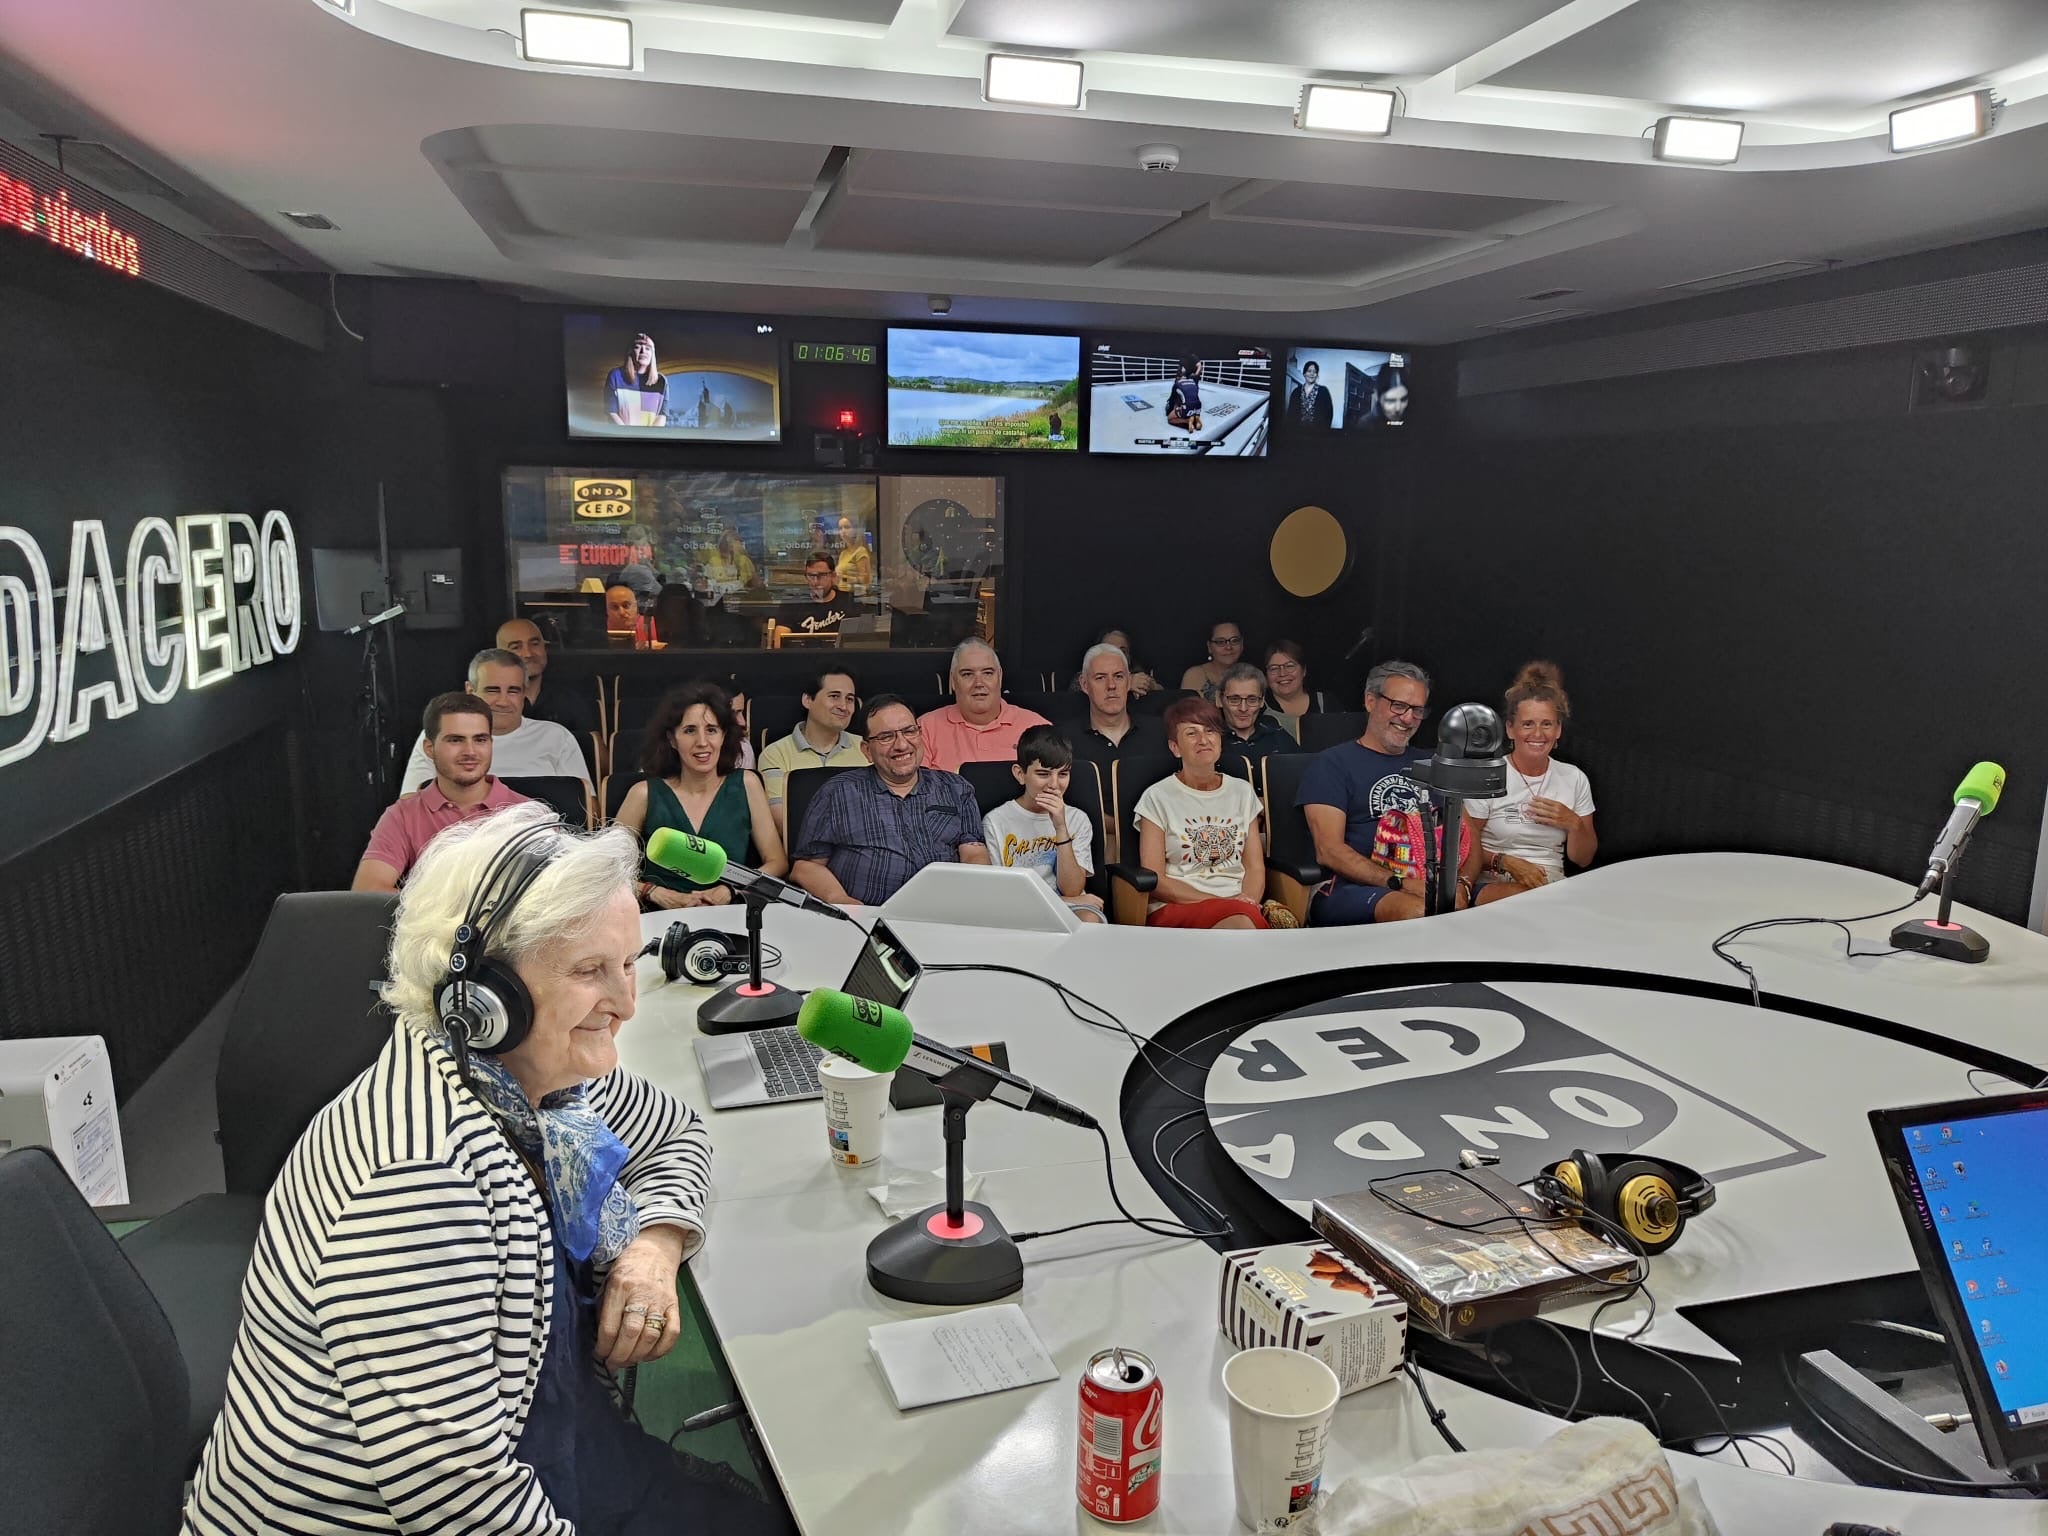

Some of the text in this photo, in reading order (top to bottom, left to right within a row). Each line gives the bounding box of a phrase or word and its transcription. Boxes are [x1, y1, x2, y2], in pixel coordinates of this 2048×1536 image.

[43, 191, 140, 276] vientos
[798, 345, 871, 362] 01:06:46
[580, 486, 625, 497] ONDA
[584, 503, 625, 513] CERO
[801, 610, 845, 635] Fender
